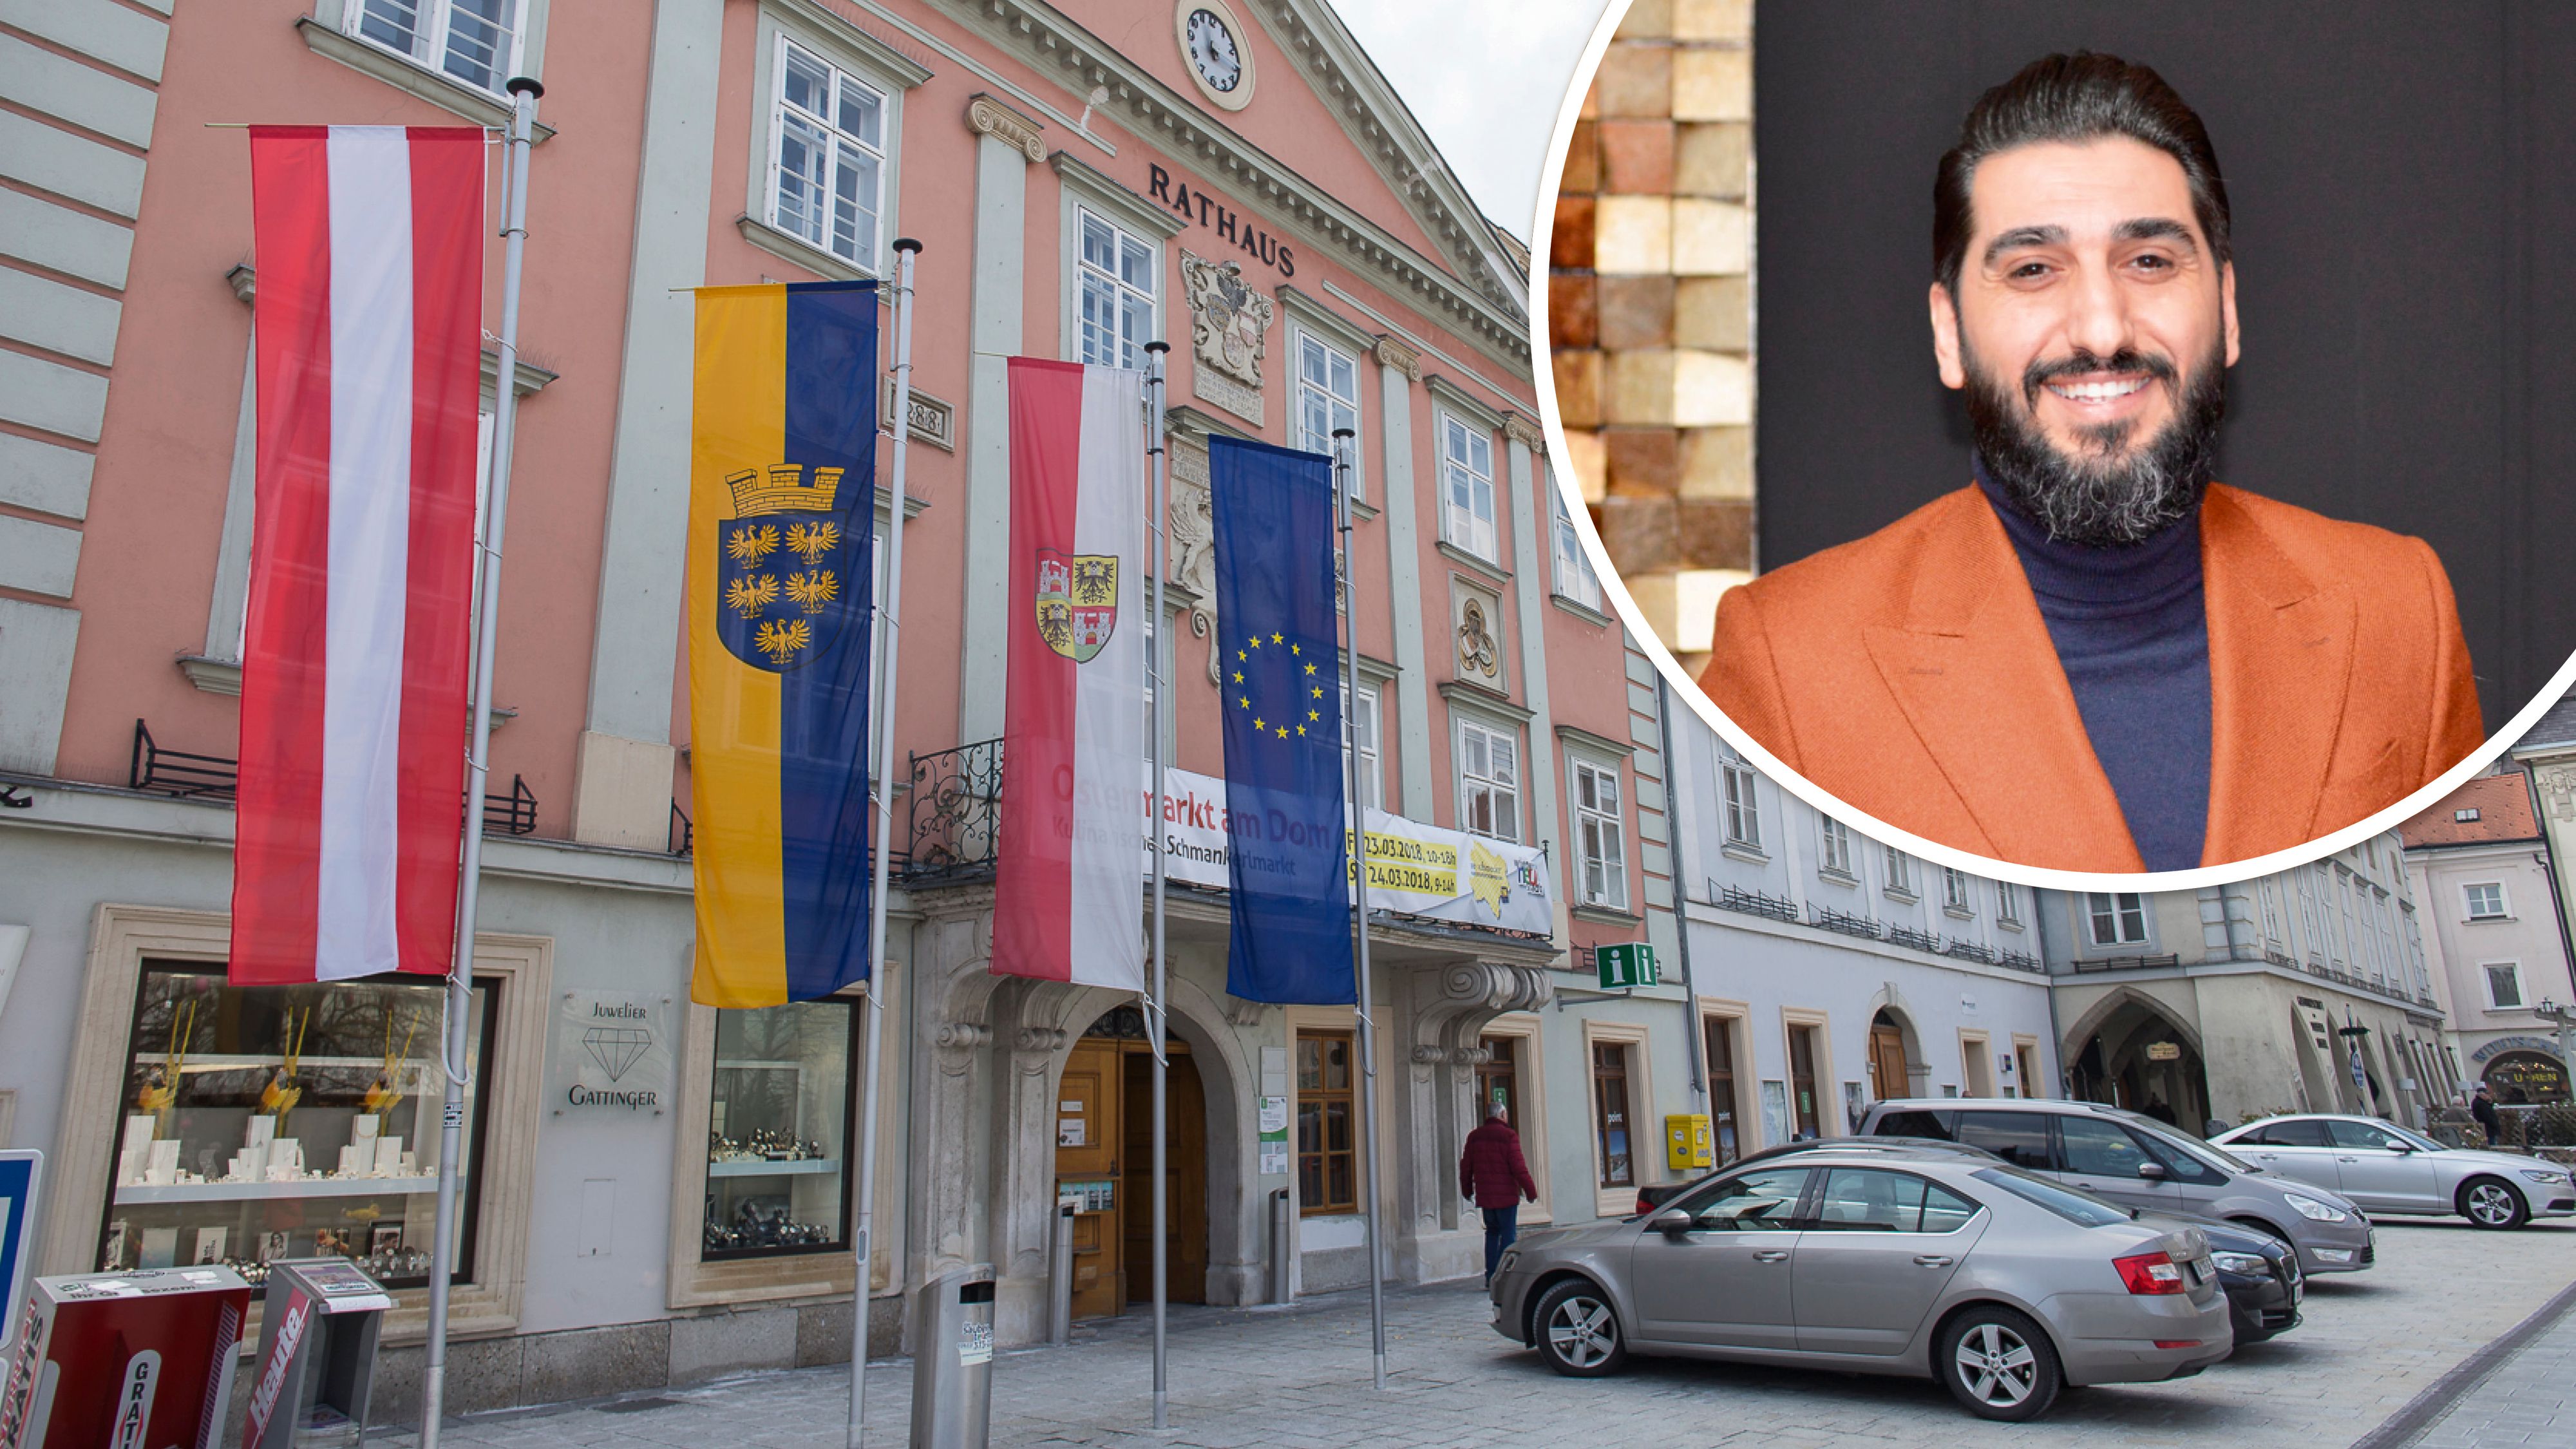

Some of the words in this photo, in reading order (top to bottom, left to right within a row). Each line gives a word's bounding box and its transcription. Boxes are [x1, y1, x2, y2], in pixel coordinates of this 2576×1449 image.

[1150, 162, 1294, 278] RATHAUS
[1267, 808, 1330, 850] Dom
[5, 1312, 44, 1449] RATIS
[250, 1307, 303, 1428] Heute
